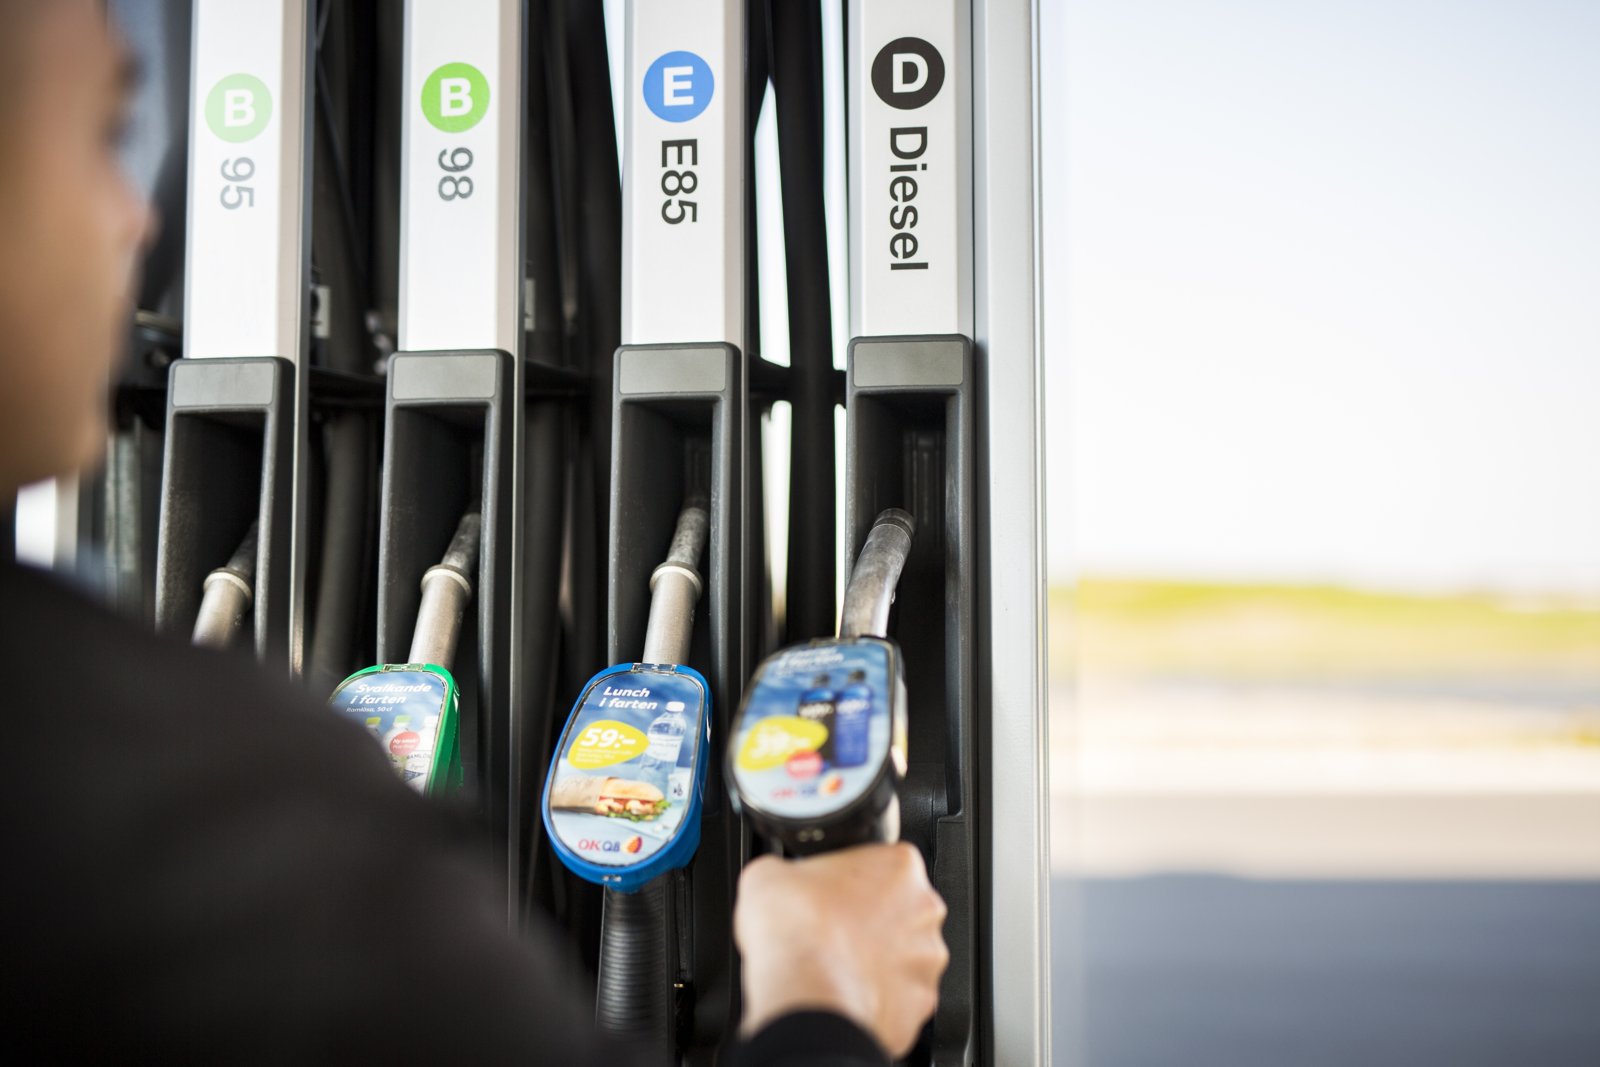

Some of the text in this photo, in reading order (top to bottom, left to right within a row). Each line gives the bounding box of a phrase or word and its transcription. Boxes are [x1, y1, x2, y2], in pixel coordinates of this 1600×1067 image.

[663, 65, 694, 106] E
[892, 52, 929, 93] D
[224, 88, 256, 128] B
[440, 77, 474, 117] B
[219, 156, 256, 210] 95
[437, 146, 475, 202] 98
[660, 138, 698, 225] E85
[889, 126, 929, 271] Diesel
[350, 694, 407, 704] i farten
[355, 684, 432, 693] Svalkande
[599, 698, 658, 710] i farten
[603, 686, 650, 698] Lunch
[579, 728, 636, 749] 59:-
